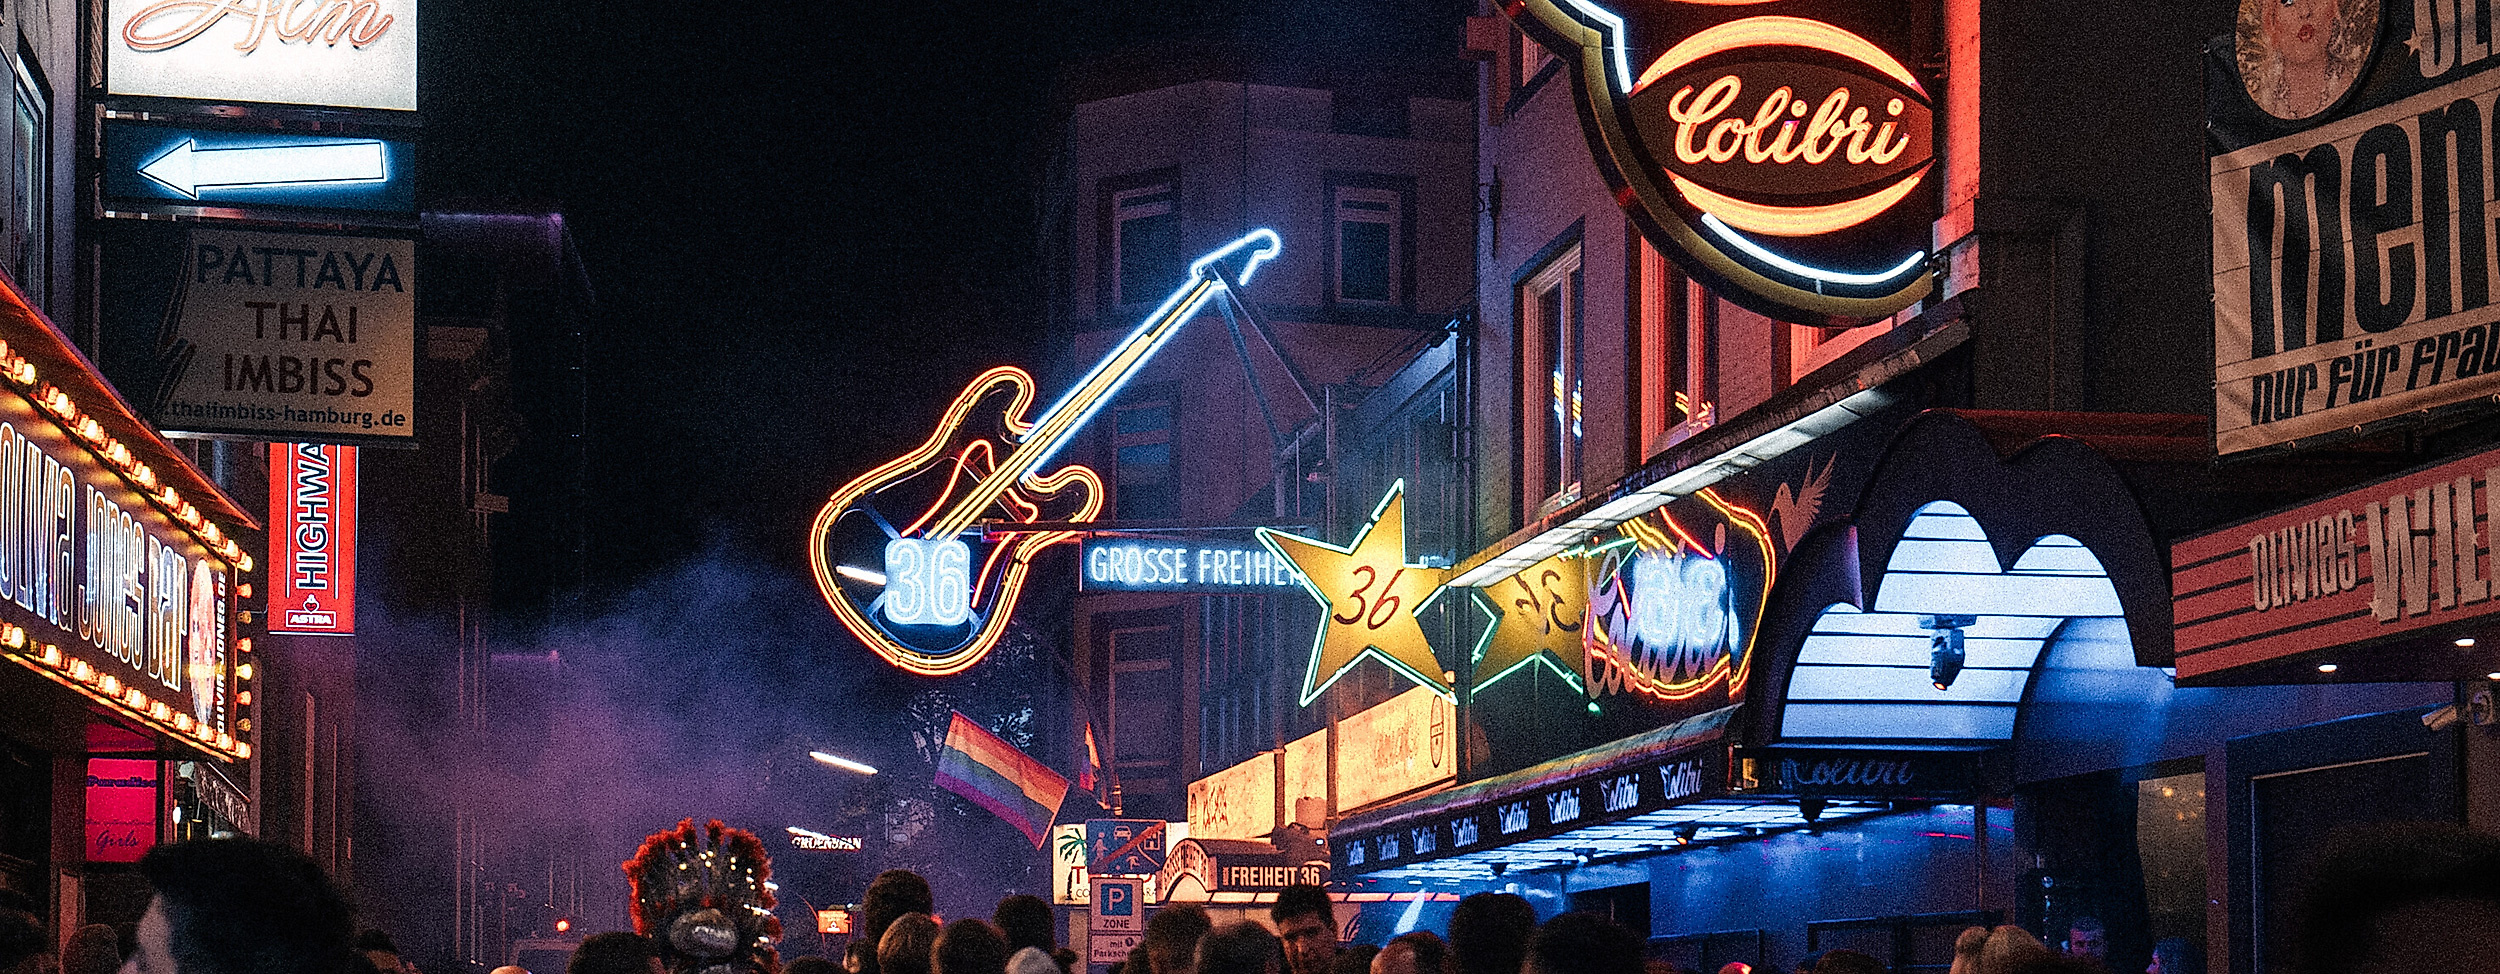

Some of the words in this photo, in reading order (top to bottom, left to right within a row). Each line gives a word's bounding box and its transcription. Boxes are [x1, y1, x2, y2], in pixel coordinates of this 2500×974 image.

[1669, 75, 1910, 164] Colibri
[196, 245, 404, 293] PATTAYA
[244, 301, 358, 344] THAI
[224, 353, 374, 397] IMBISS
[2251, 363, 2318, 426] nur
[2326, 338, 2401, 409] für
[887, 540, 968, 622] 36
[1091, 547, 1188, 585] GROSSE
[1334, 566, 1404, 631] 36
[289, 614, 332, 624] ASTRA
[96, 830, 138, 855] Girls
[1231, 866, 1298, 886] FREIHEIT
[1300, 866, 1320, 886] 36
[1108, 888, 1125, 911] P
[1103, 919, 1130, 929] ZONE
[1110, 940, 1123, 948] mit
